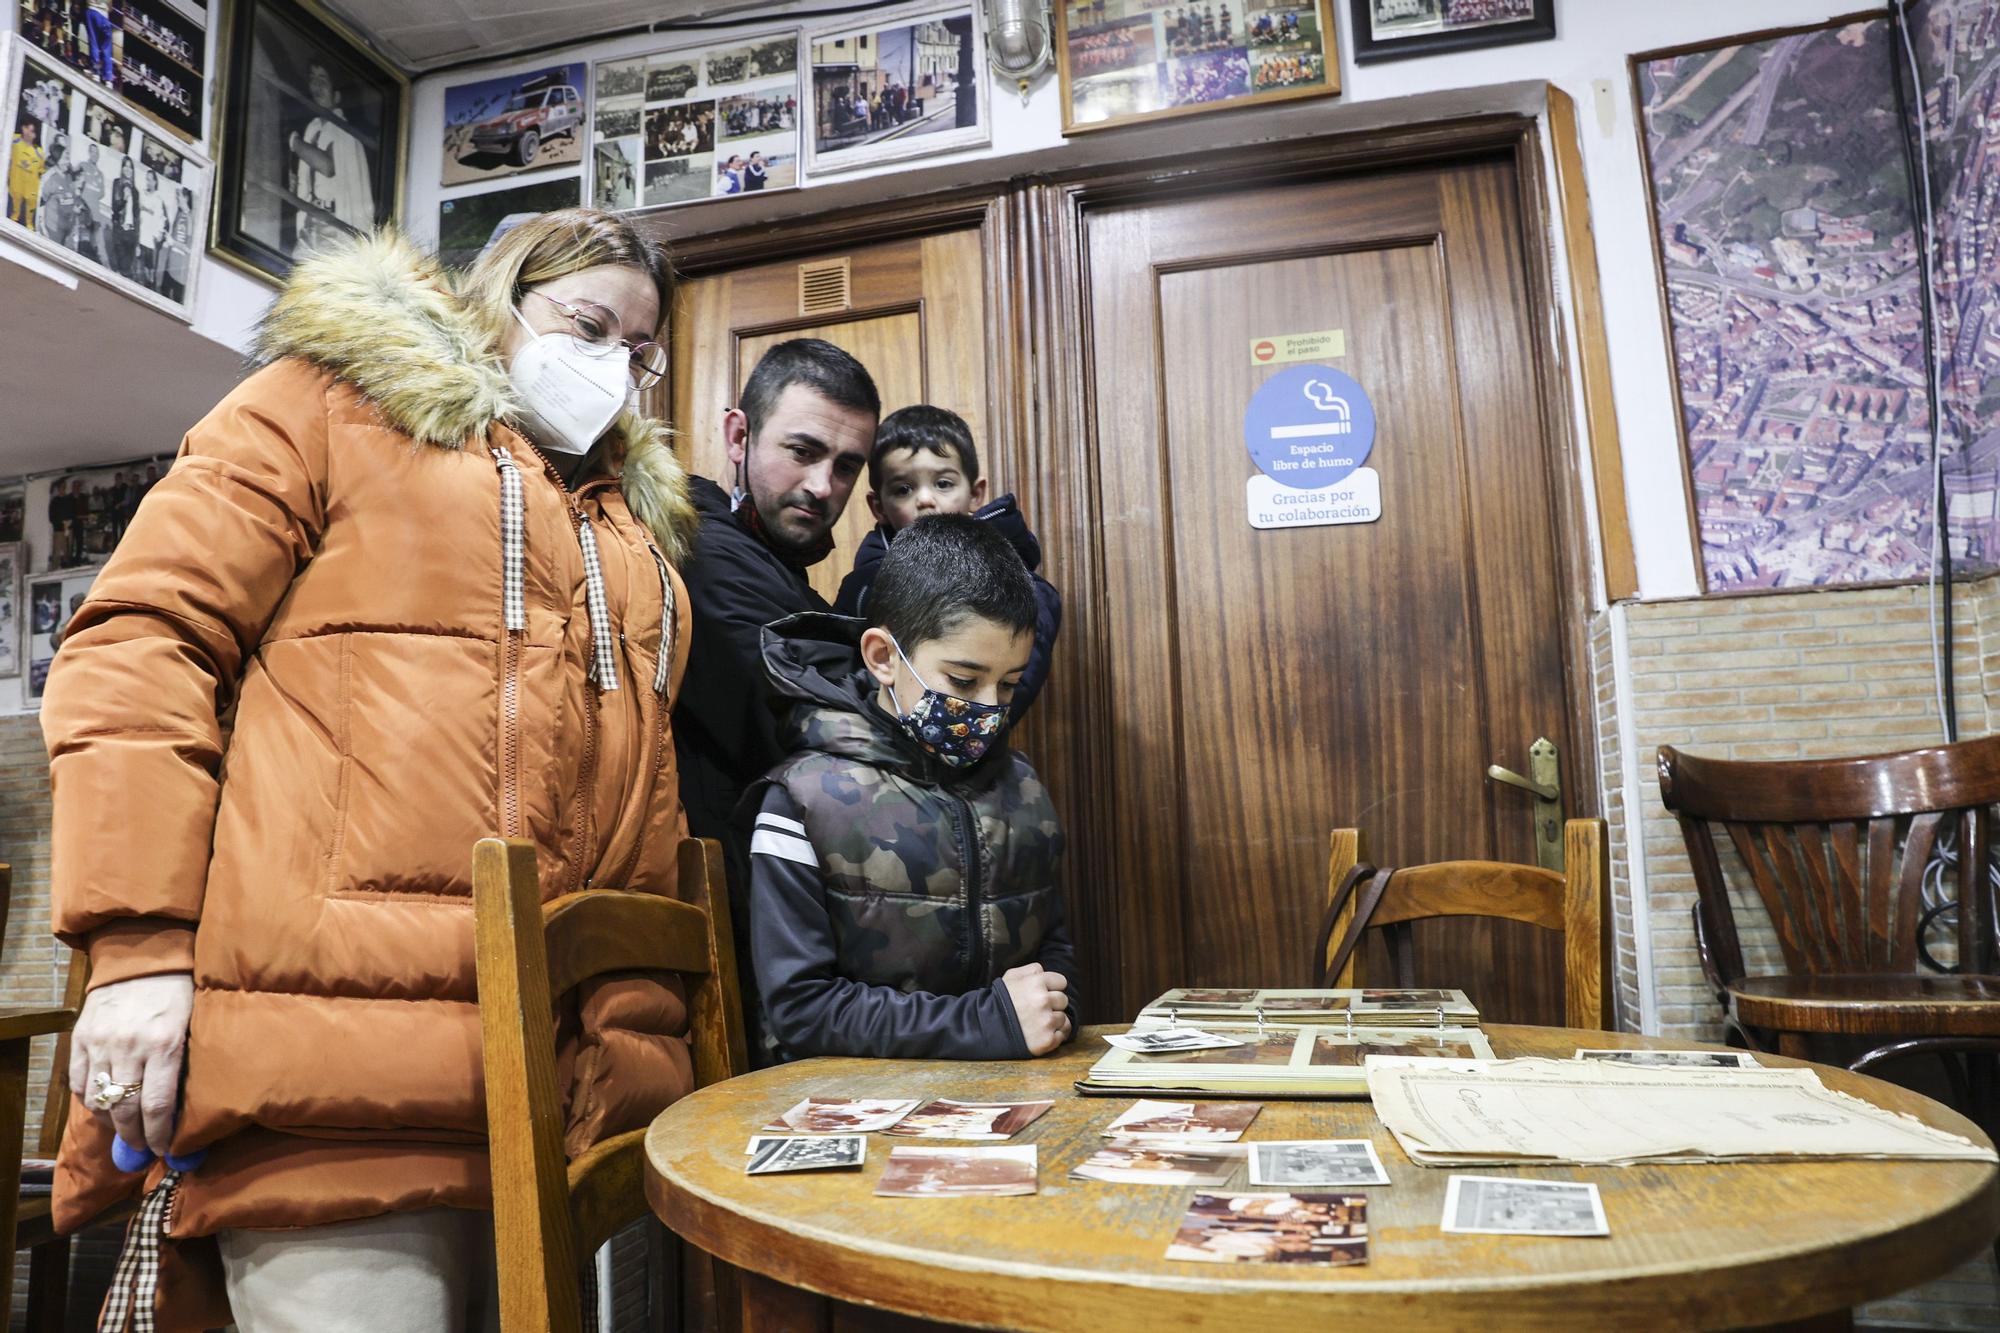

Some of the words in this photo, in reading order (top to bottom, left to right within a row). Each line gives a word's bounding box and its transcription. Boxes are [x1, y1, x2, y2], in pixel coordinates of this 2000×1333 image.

[1286, 336, 1331, 347] Prohibido
[1288, 347, 1295, 355] el
[1298, 345, 1320, 355] paso
[1290, 442, 1334, 457] Espacio
[1272, 460, 1299, 471] libre
[1301, 458, 1316, 469] de
[1318, 456, 1354, 468] humo
[1272, 491, 1326, 505] Gracias
[1330, 490, 1355, 505] por
[1259, 512, 1274, 523] tu
[1278, 504, 1371, 522] colaboración
